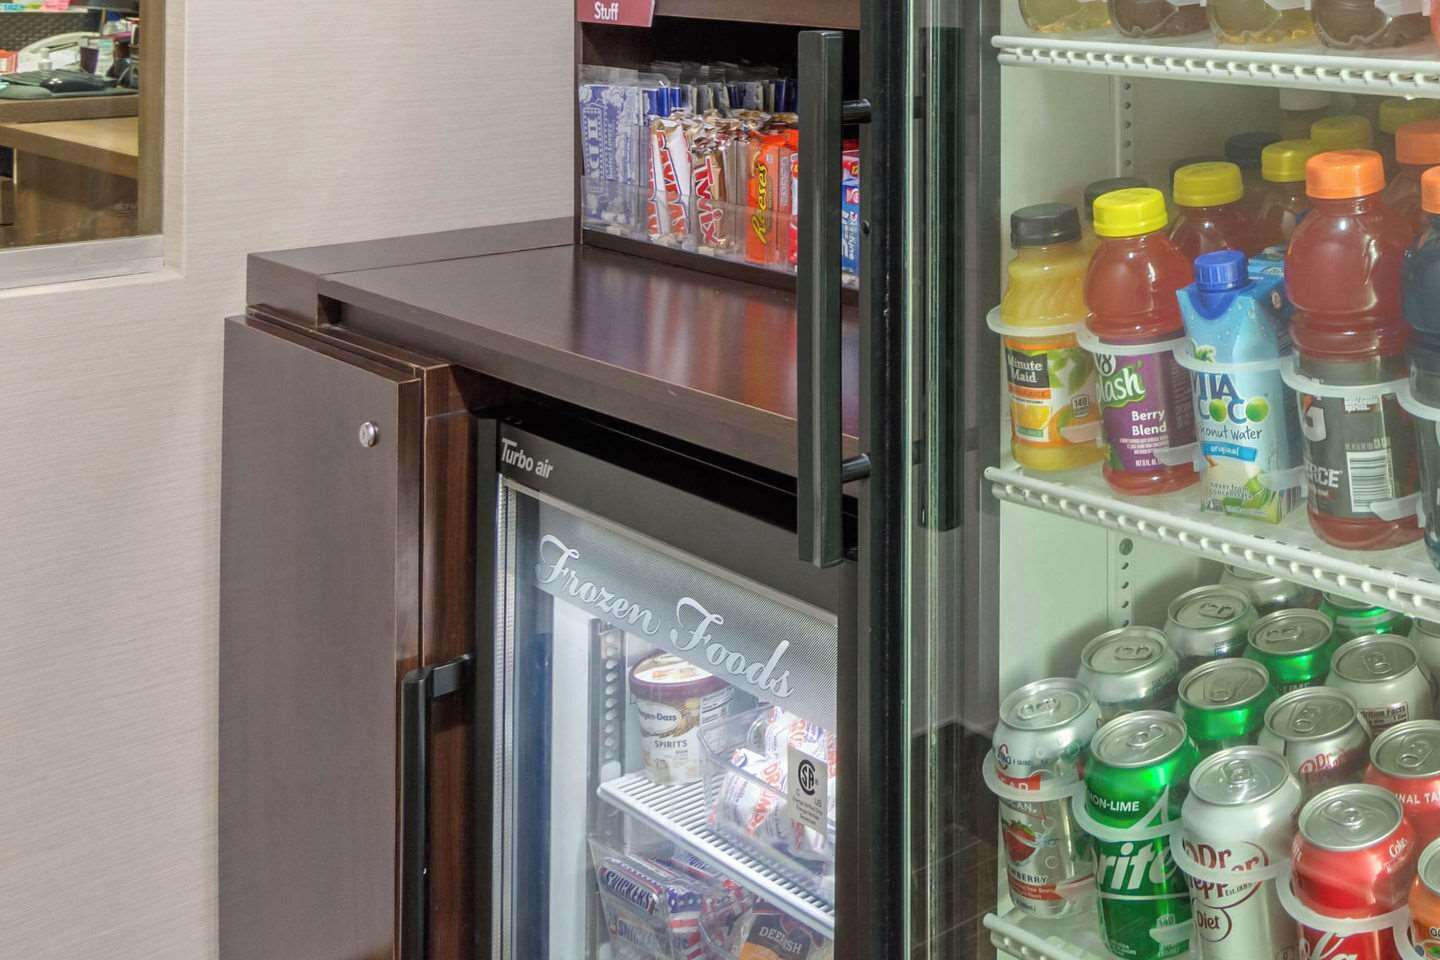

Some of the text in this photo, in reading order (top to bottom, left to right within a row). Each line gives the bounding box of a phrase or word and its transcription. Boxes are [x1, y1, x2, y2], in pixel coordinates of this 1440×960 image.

[594, 1, 619, 21] Stuff
[692, 154, 724, 245] Twix
[1008, 356, 1043, 372] Minute
[1011, 371, 1040, 384] Maid
[1131, 409, 1166, 422] Berry
[1131, 421, 1168, 437] Blend
[1229, 424, 1263, 441] water
[501, 437, 554, 479] Turbo air
[536, 534, 794, 698] Frozen Foods
[653, 738, 688, 749] SPIRITS
[1196, 910, 1220, 930] Diet
